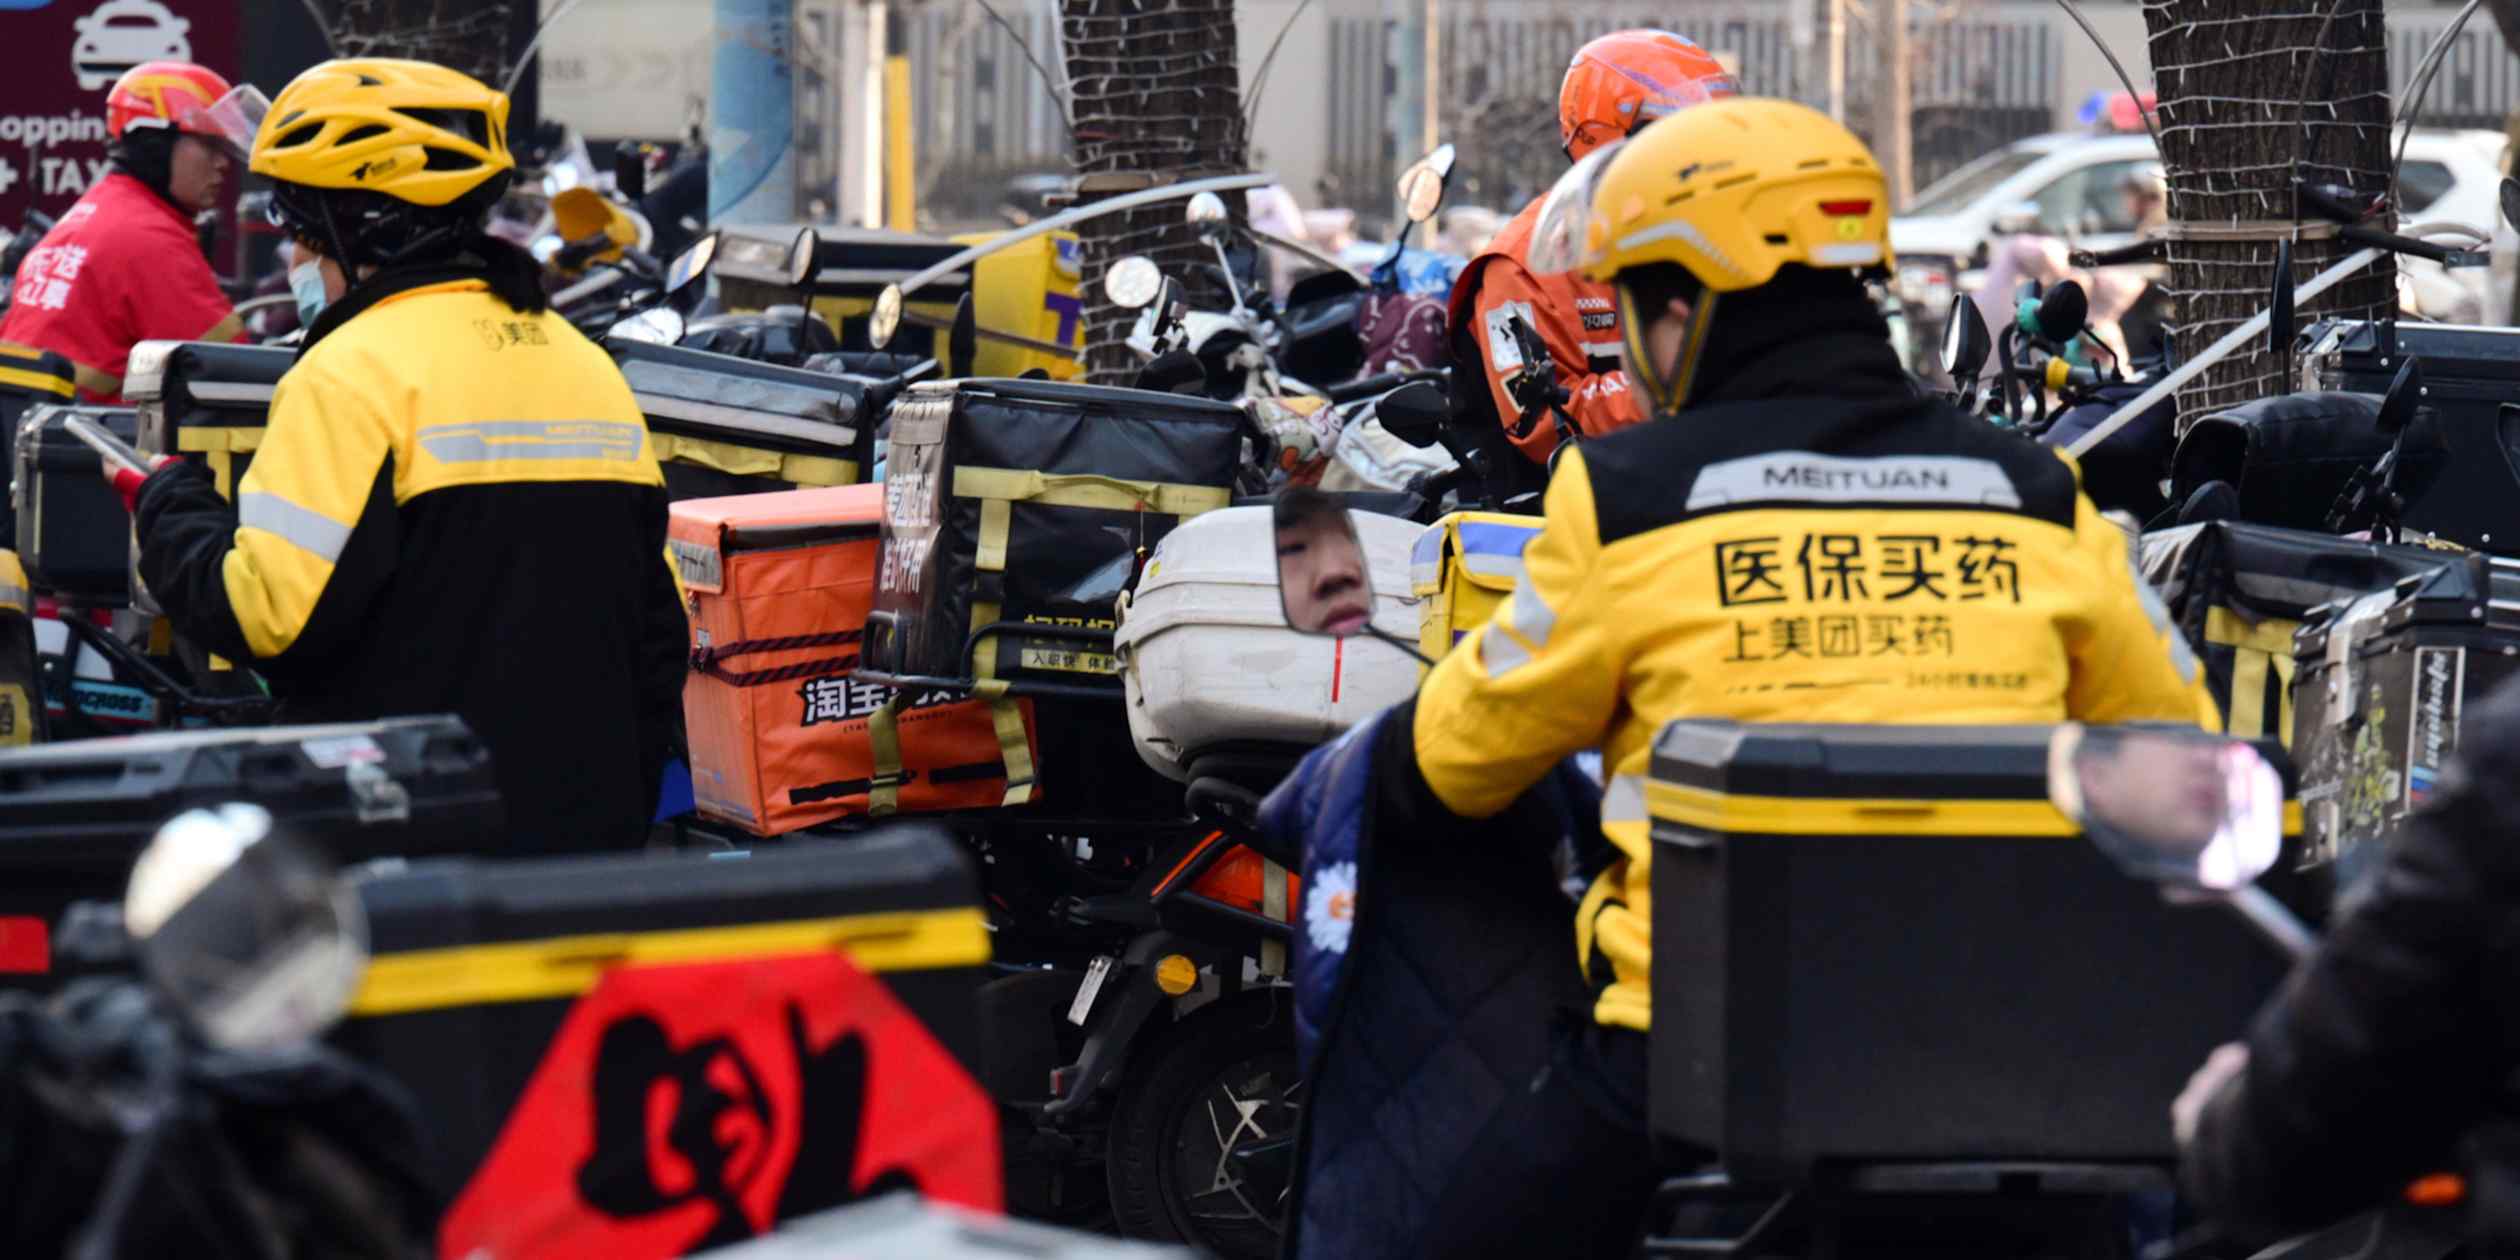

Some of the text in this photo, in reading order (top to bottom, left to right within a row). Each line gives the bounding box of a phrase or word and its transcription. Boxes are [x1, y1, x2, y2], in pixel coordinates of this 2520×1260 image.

[1762, 466, 1949, 490] MEITUAN
[1714, 533, 2021, 607] 医保买药
[1722, 614, 1953, 663] 上美团买药
